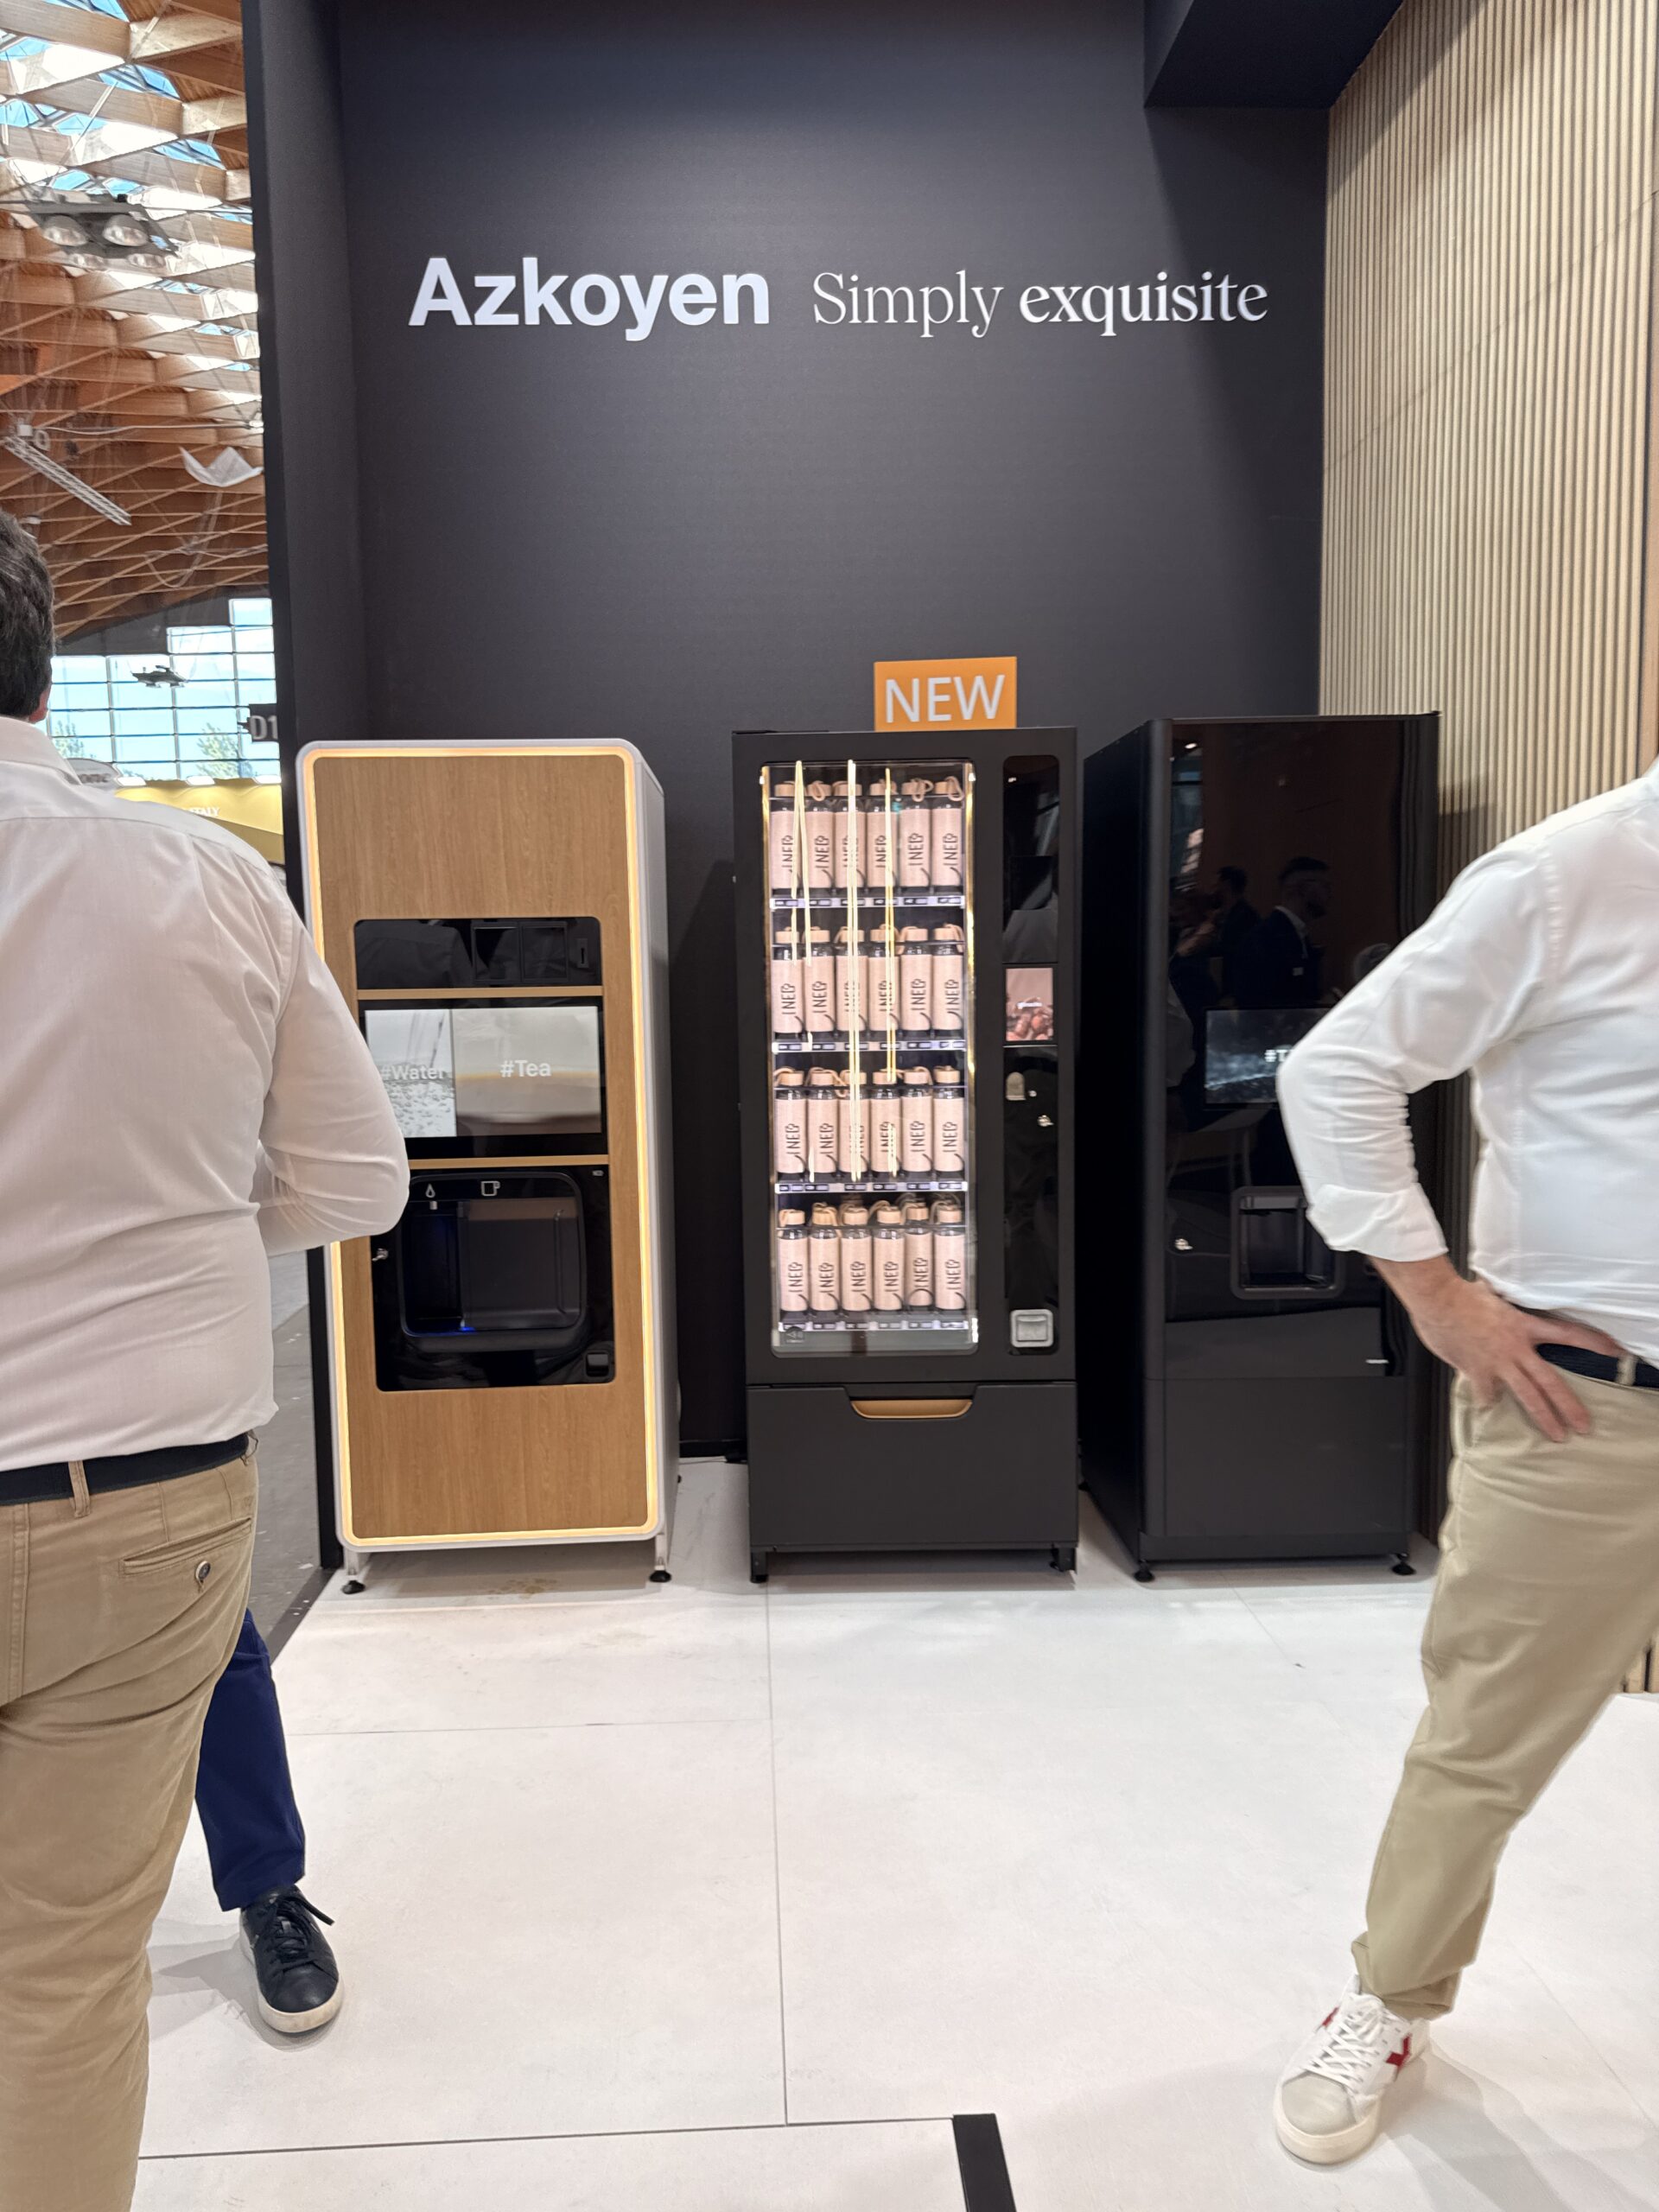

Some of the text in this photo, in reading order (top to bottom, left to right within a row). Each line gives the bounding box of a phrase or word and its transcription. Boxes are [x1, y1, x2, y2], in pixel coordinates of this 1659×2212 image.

[408, 257, 1268, 341] Azkoyen Simply exquisite
[885, 674, 1005, 723] NEW
[499, 1059, 551, 1077] #Tea
